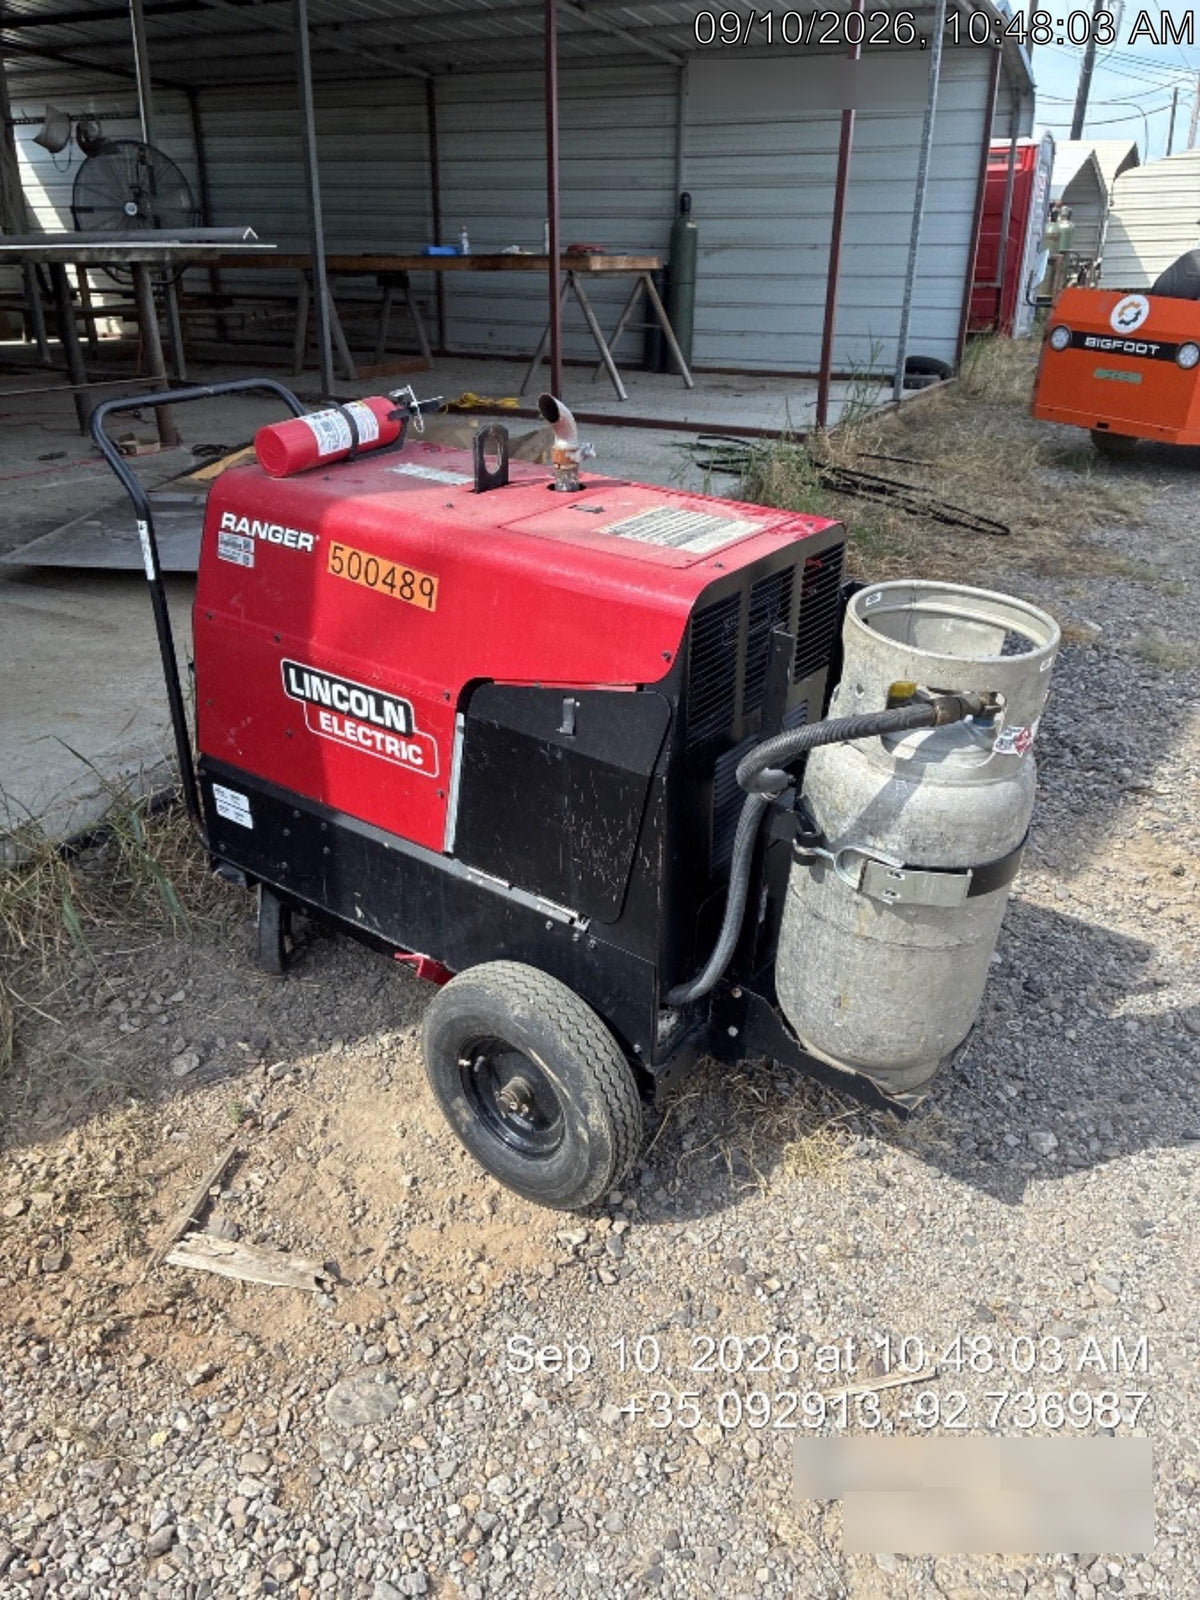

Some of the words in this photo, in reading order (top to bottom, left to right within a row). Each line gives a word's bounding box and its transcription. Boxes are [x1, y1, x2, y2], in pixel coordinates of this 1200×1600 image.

[1085, 337, 1160, 355] BIGFOOT
[331, 546, 435, 608] 500489
[289, 668, 406, 733] LINCOLN
[319, 712, 424, 765] ELECTRIC
